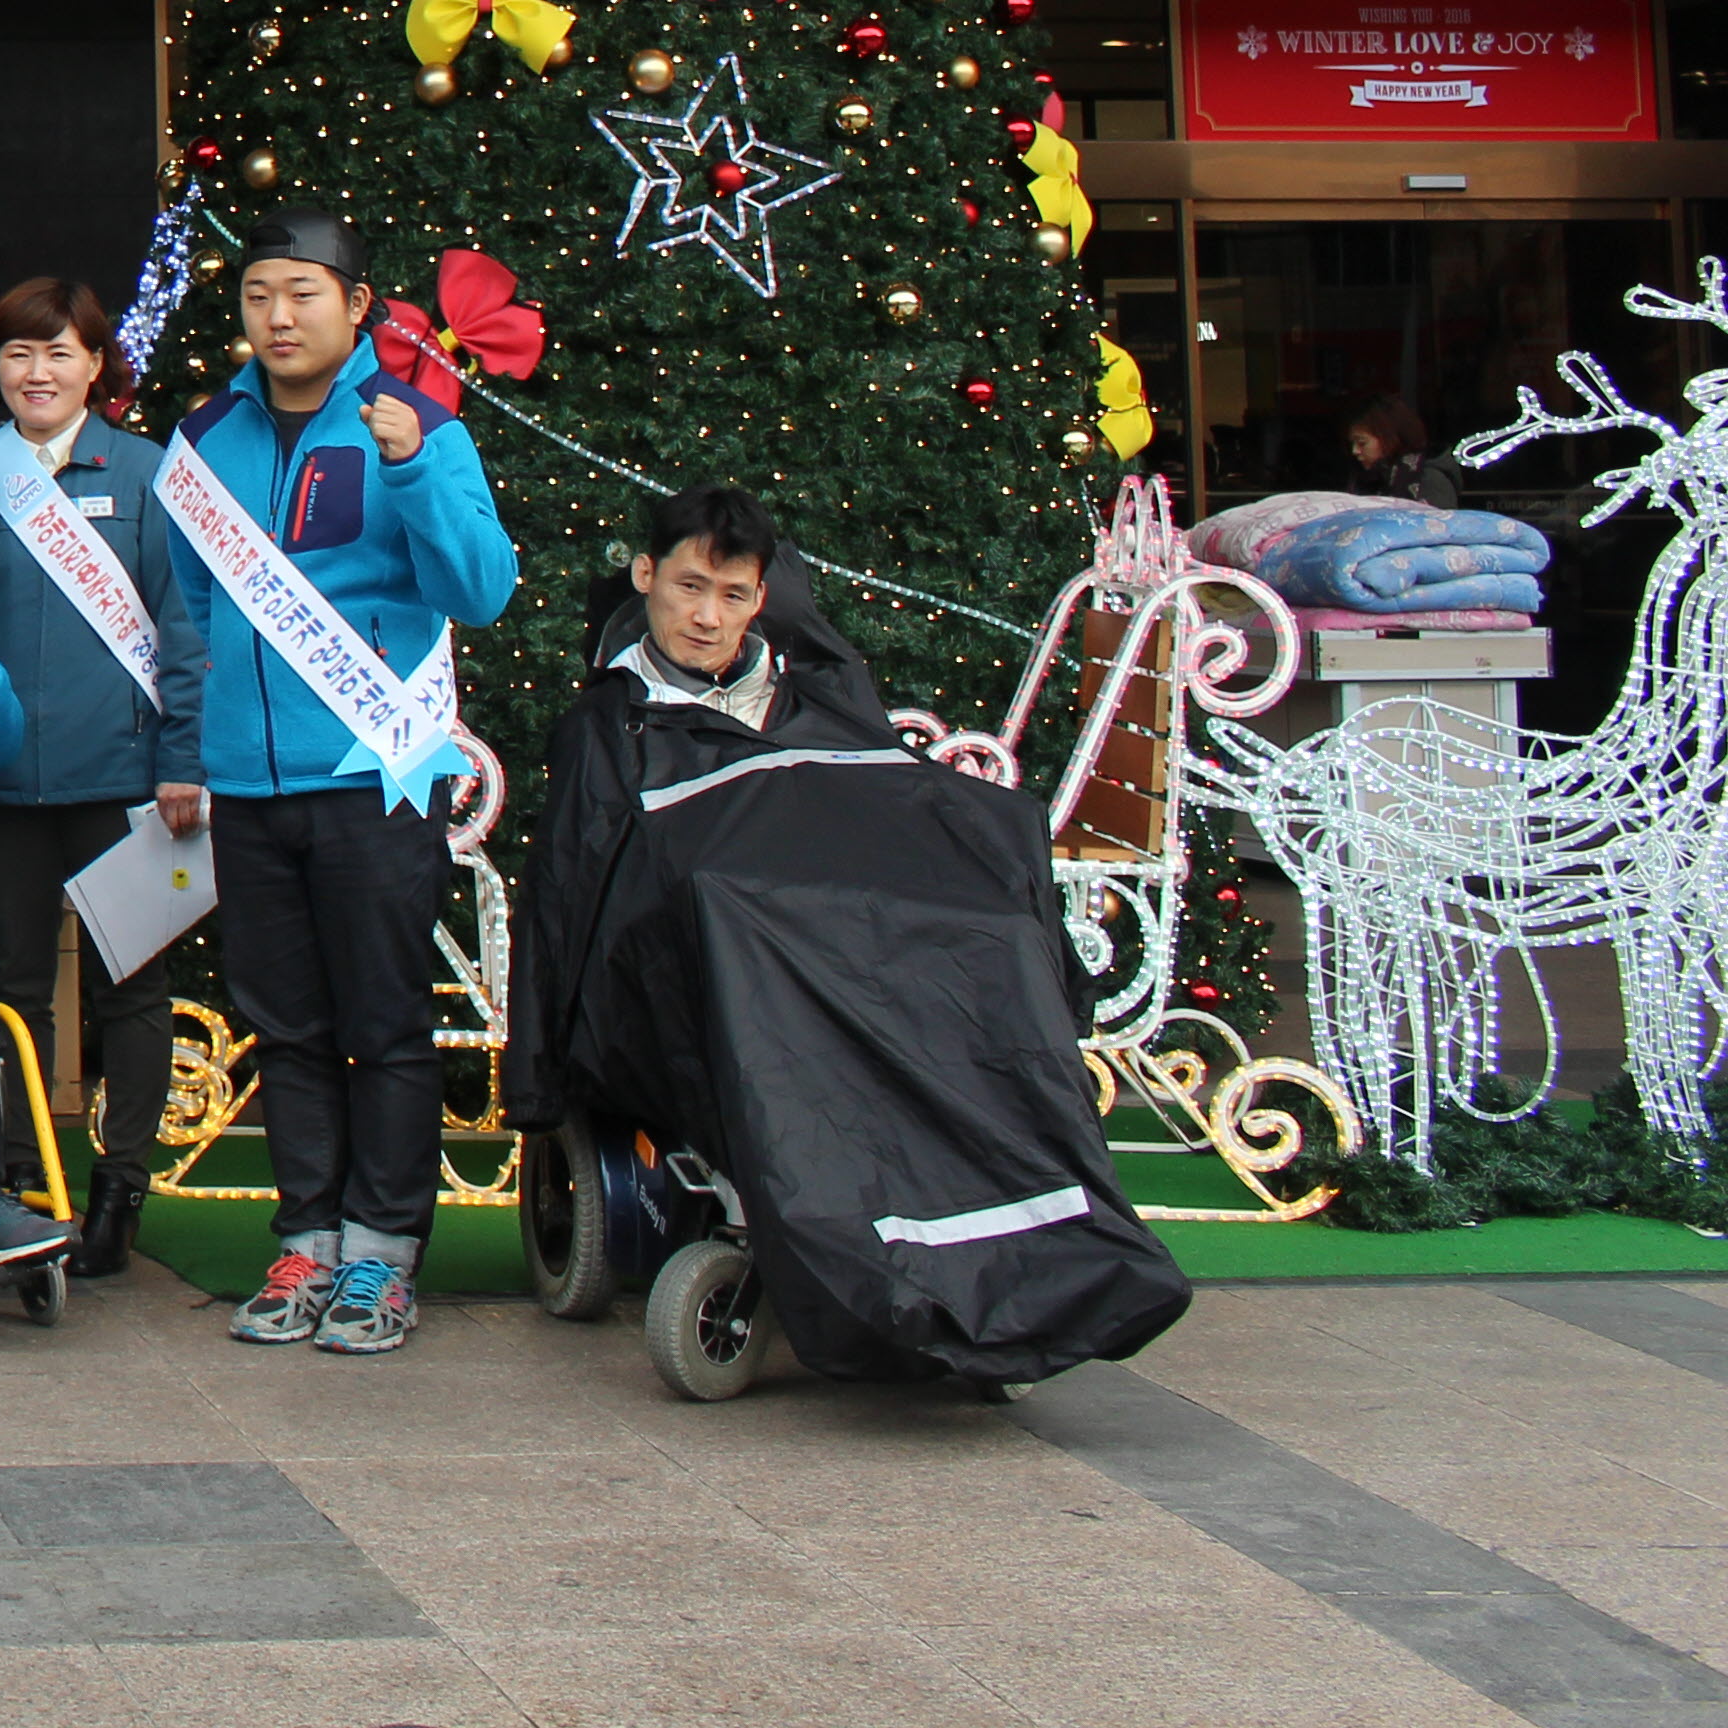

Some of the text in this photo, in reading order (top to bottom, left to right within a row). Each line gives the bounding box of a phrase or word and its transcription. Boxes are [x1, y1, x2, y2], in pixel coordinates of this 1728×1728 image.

[1358, 7, 1472, 25] WISHING YOU 2016
[1277, 30, 1555, 55] WINTER LOVE & JOY
[1374, 83, 1462, 98] HAPPY NEW YEAR
[27, 502, 141, 642] 장애인전용주차구역
[164, 454, 259, 578] 장애인전용주차구역
[242, 558, 328, 651] 장애인에게
[307, 633, 402, 733] 양보하세요
